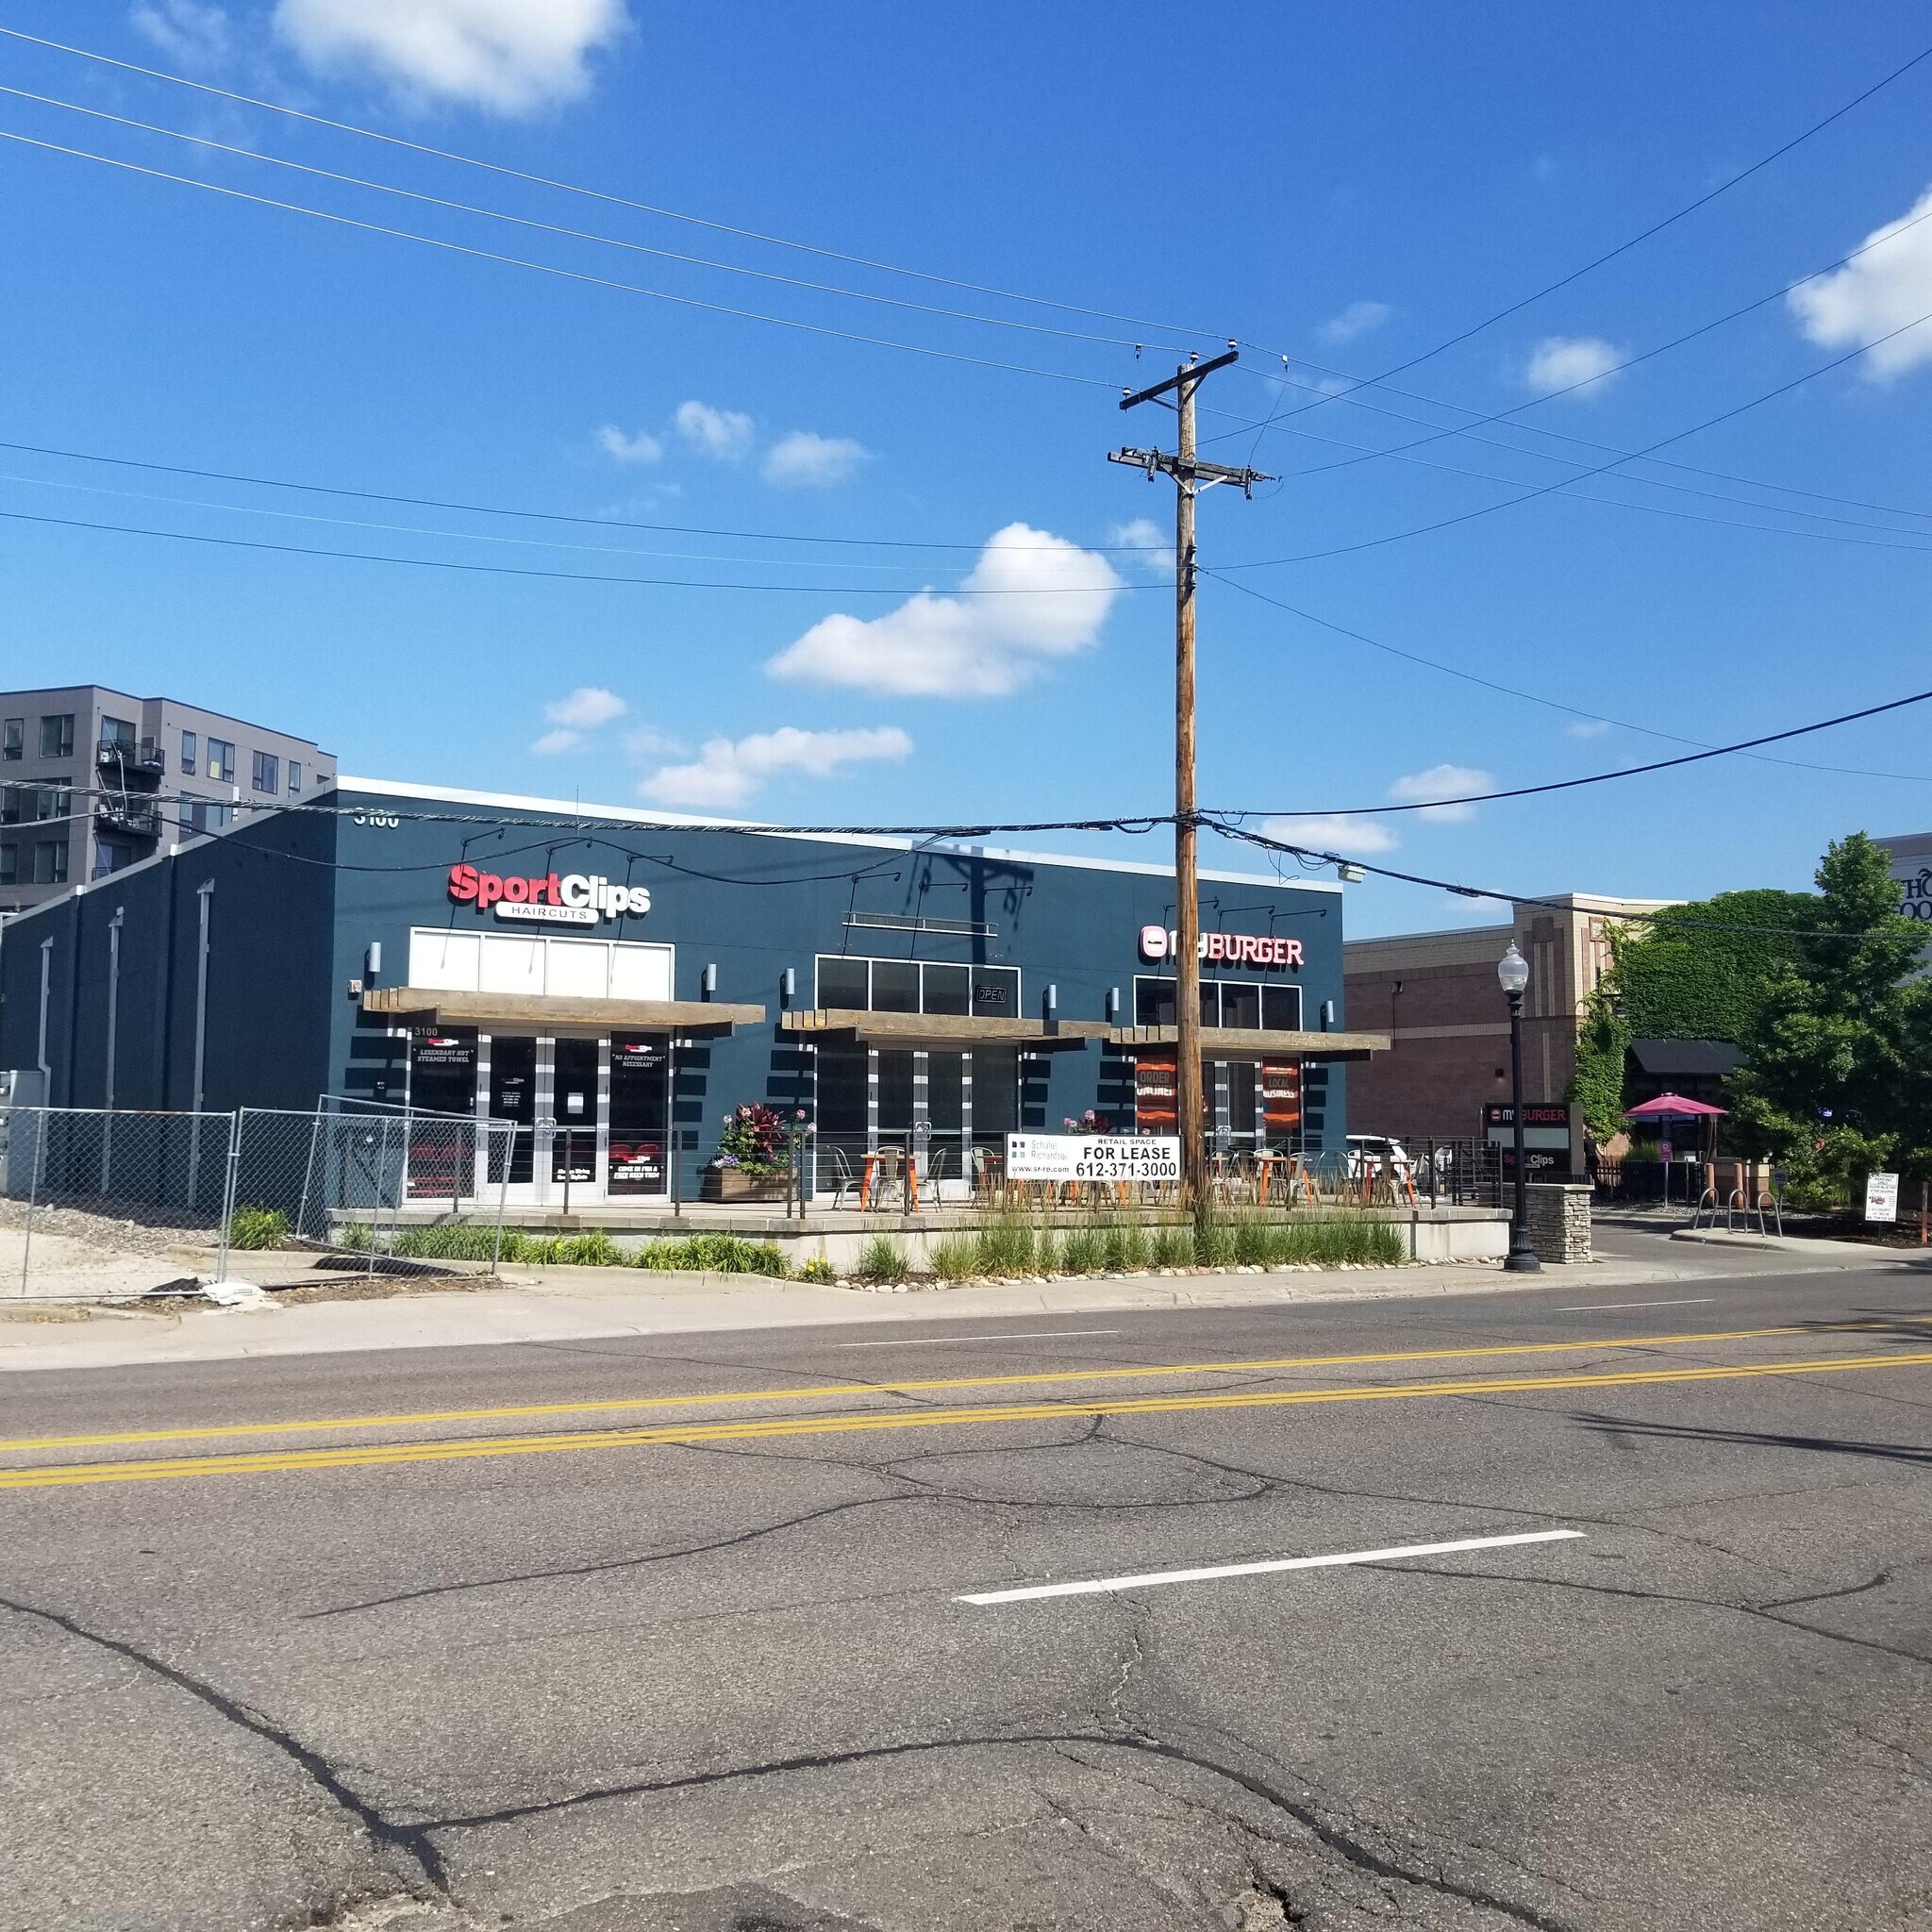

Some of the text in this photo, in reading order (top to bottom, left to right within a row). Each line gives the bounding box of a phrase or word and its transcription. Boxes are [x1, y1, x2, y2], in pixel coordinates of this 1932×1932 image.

[511, 907, 587, 920] HAIRCUTS
[979, 989, 1005, 1001] OPEN
[415, 1027, 438, 1036] 3100
[1141, 1071, 1170, 1084] ORDER
[1269, 1077, 1290, 1088] LOCAL
[1262, 1089, 1295, 1099] BUSINESS
[1503, 1108, 1566, 1122] MBURGER
[1083, 1147, 1171, 1159] FOR LEASE
[1075, 1162, 1176, 1177] 612-371-3000
